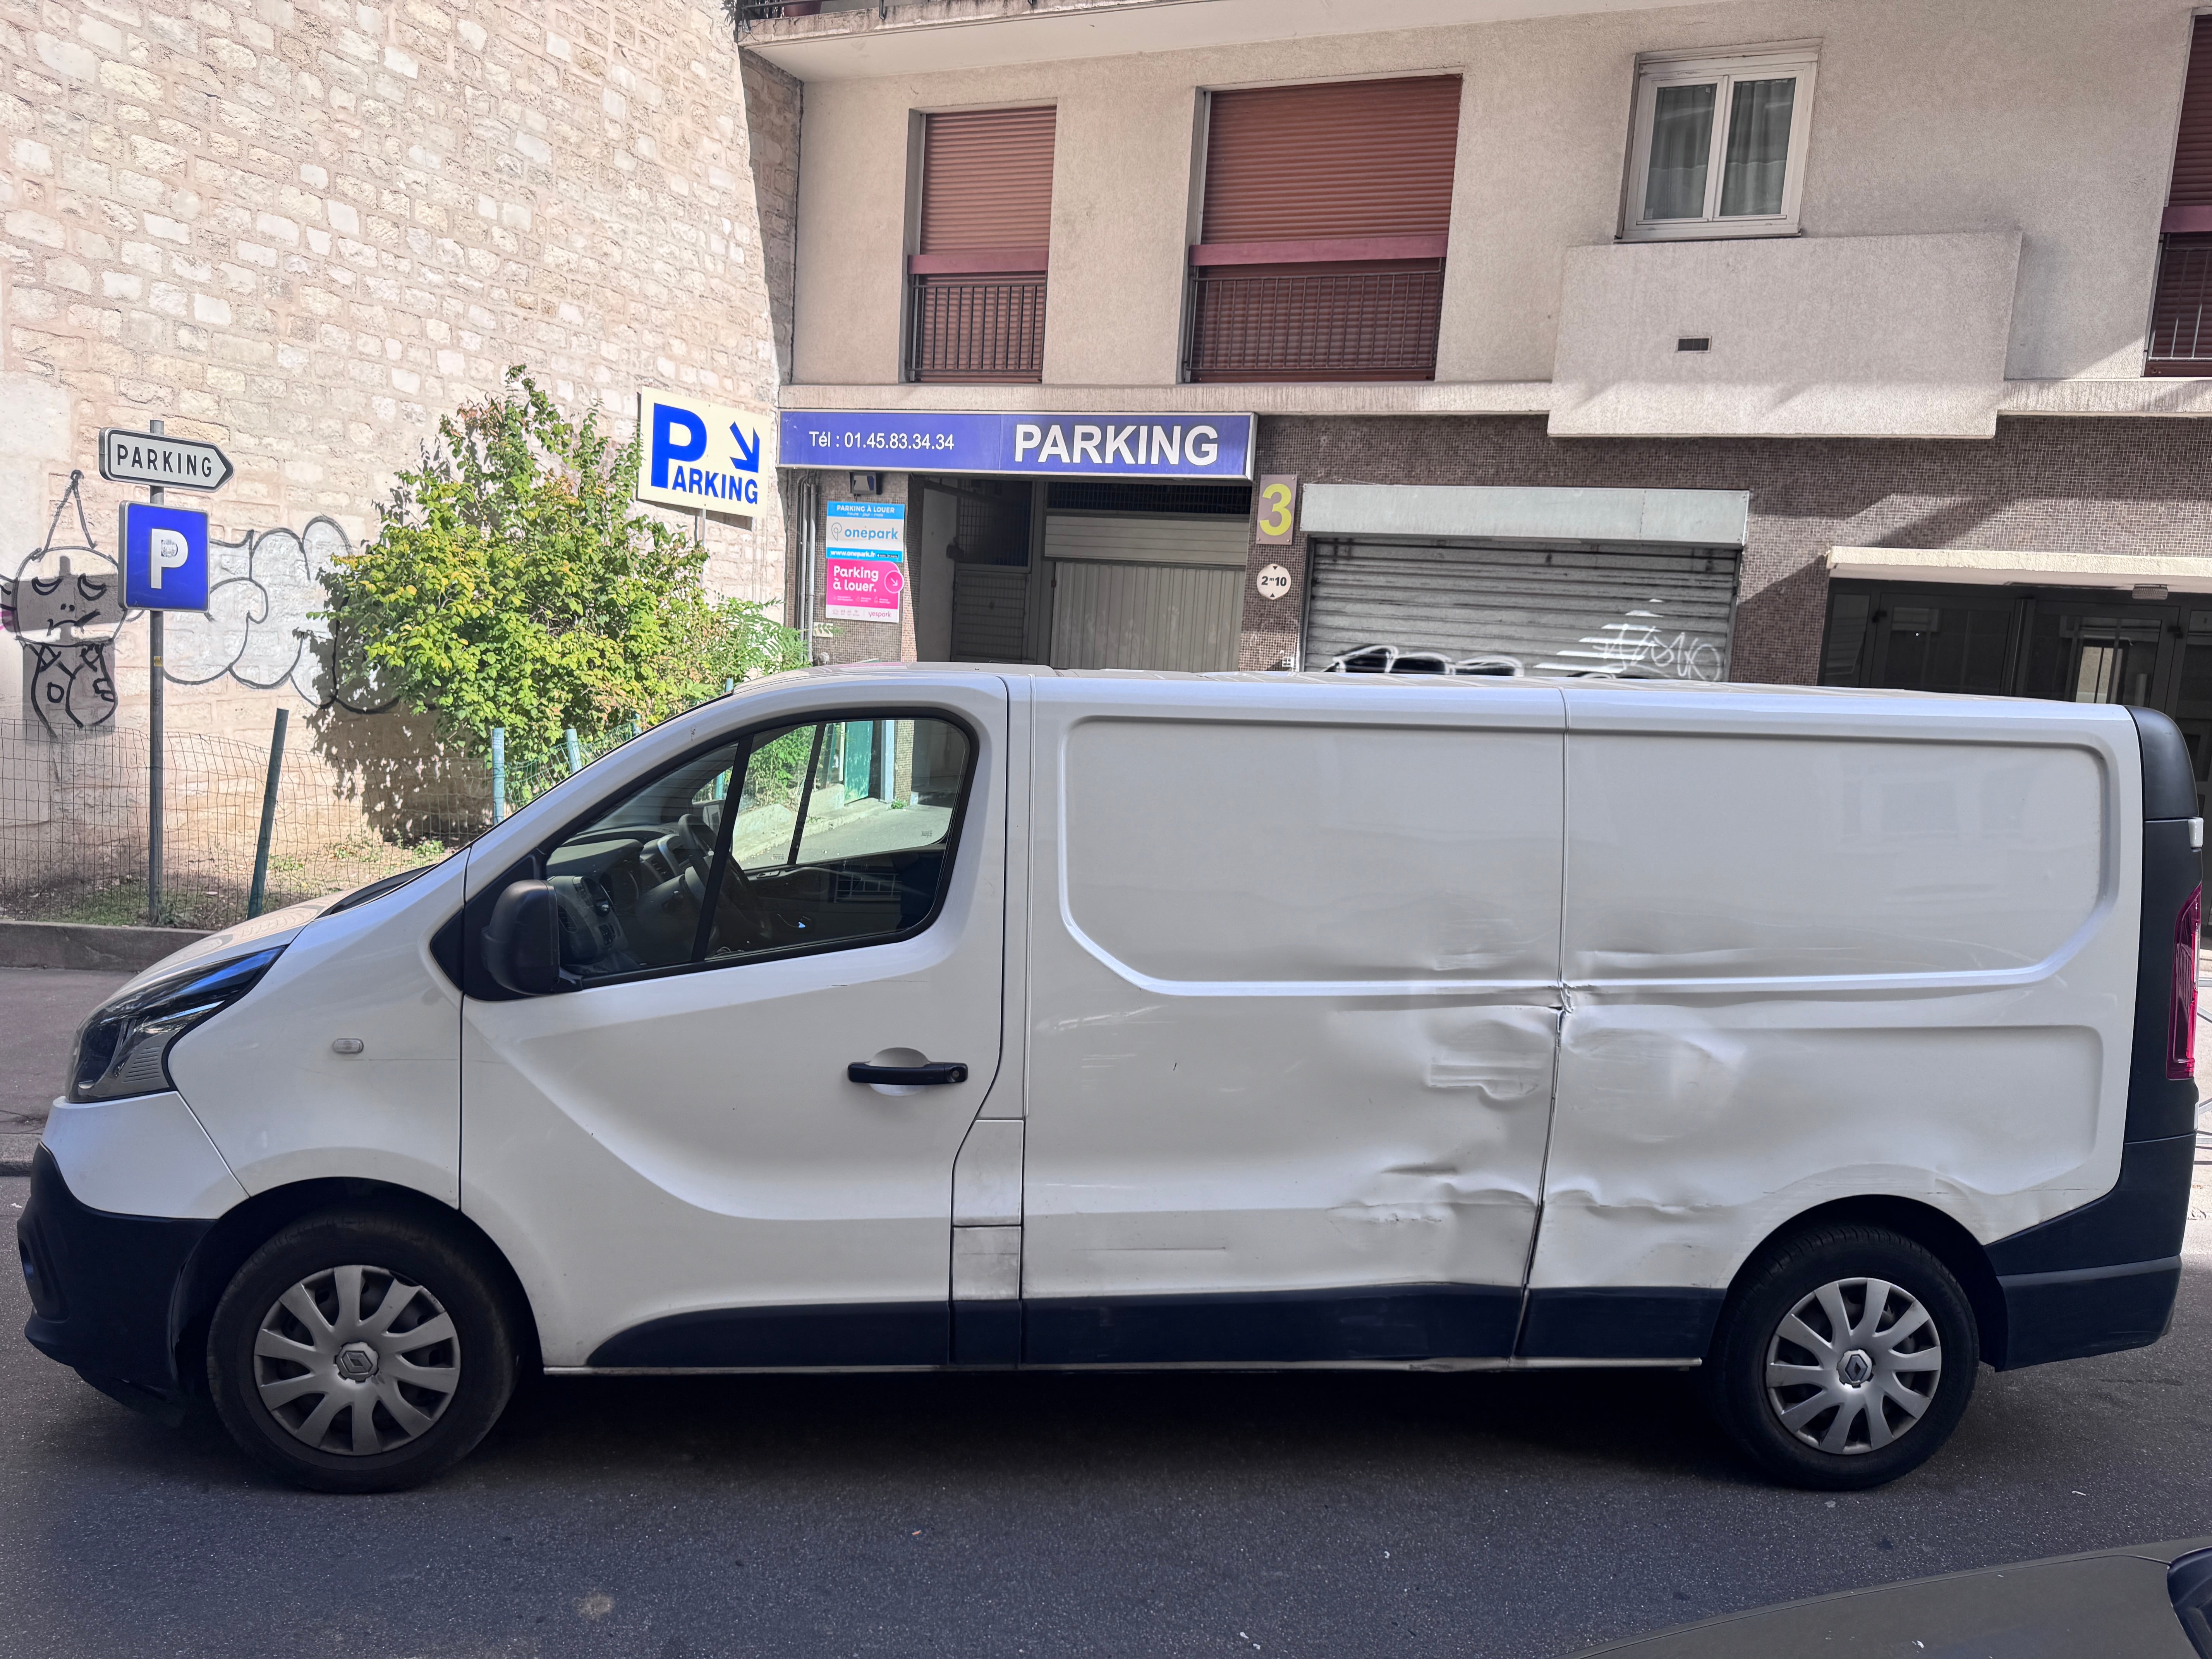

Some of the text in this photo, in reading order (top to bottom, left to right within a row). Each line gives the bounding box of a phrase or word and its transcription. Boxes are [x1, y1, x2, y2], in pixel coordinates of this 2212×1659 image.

[809, 431, 831, 447] Tél
[844, 432, 954, 450] 01.45.83.34.34
[1015, 424, 1218, 466] PARKING
[117, 444, 211, 477] PARKING
[1260, 484, 1292, 536] 3
[845, 528, 898, 540] onepark
[151, 528, 188, 589] P
[833, 577, 877, 592] à louer.
[834, 565, 879, 582] Parking
